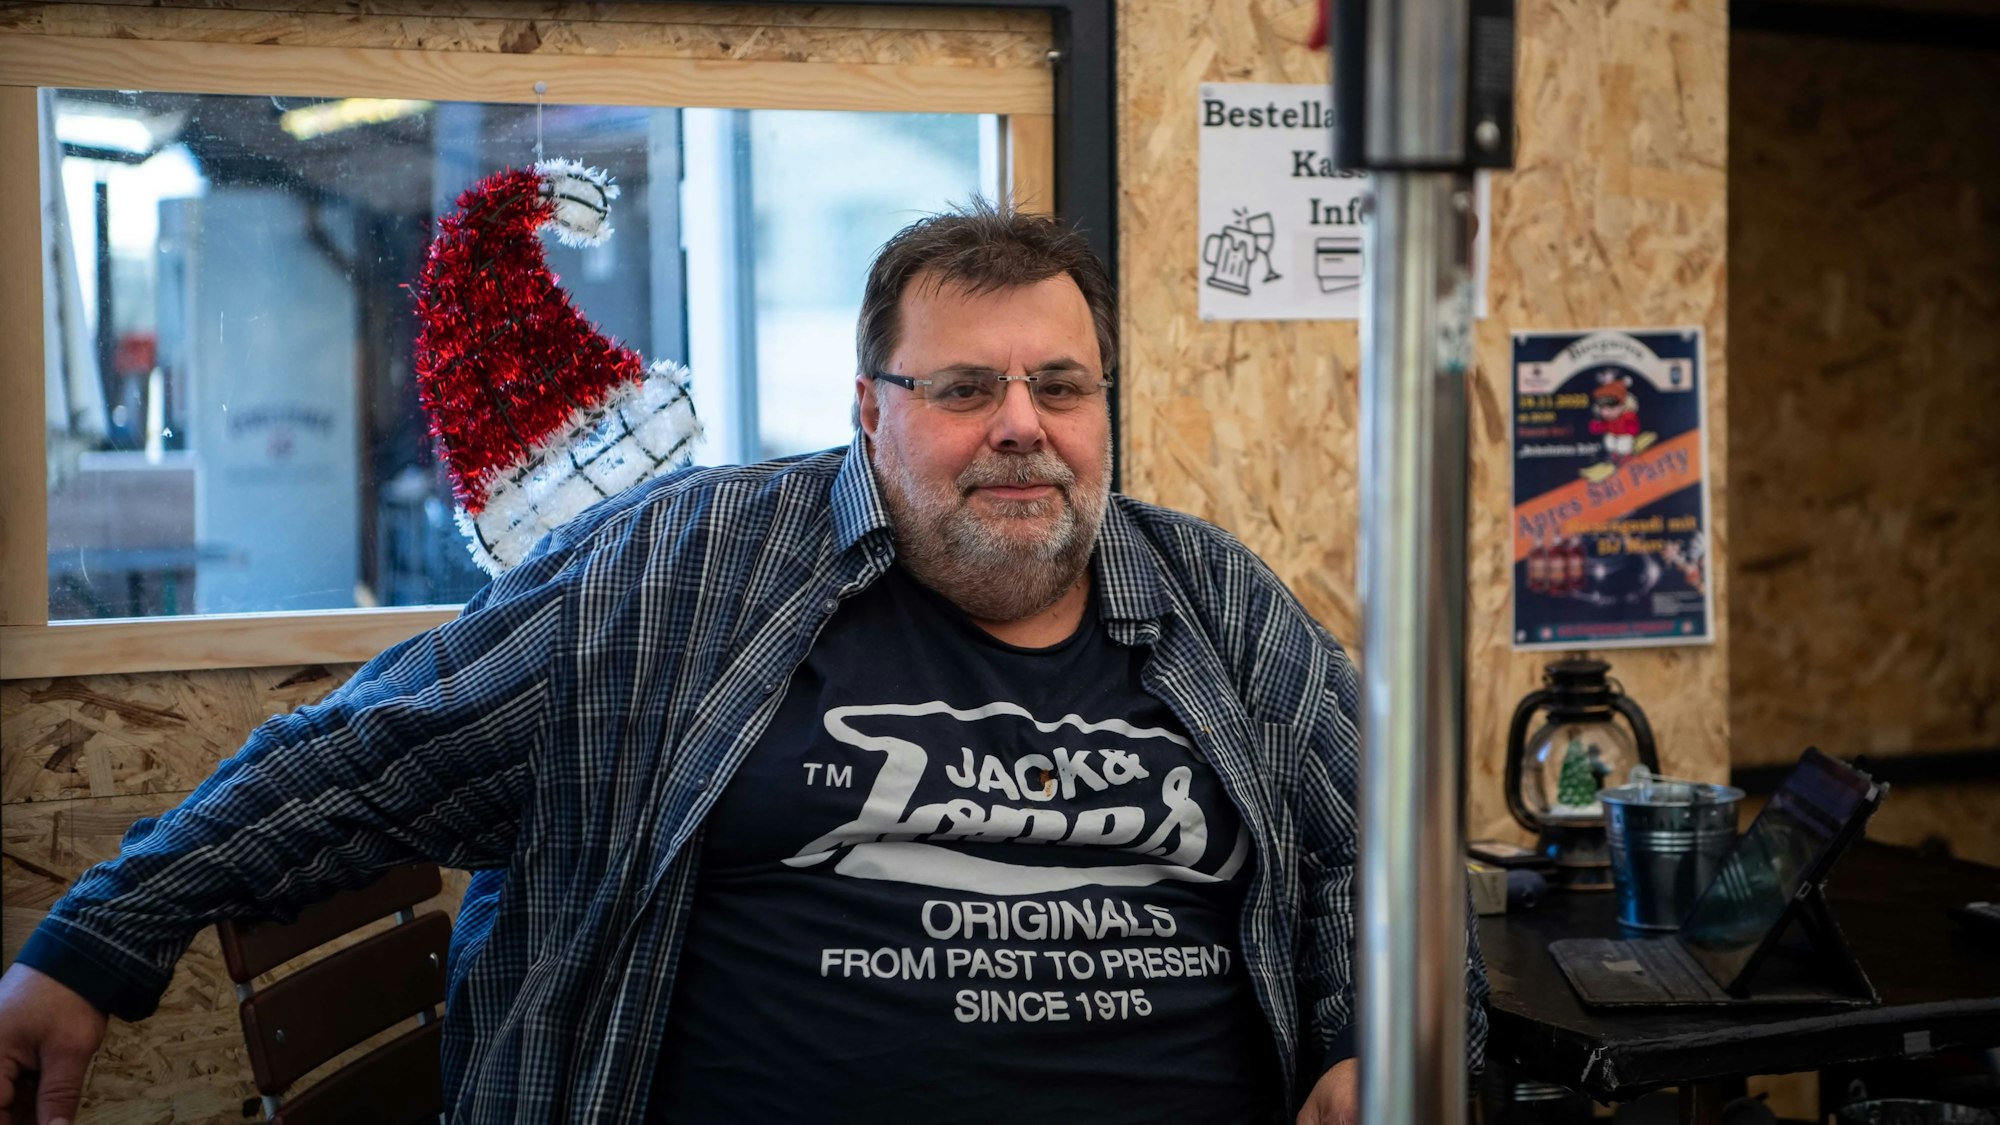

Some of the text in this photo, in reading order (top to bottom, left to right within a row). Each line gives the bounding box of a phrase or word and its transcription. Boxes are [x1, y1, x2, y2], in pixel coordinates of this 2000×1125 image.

[1587, 473, 1625, 507] Ski
[1629, 447, 1689, 488] Party
[803, 762, 853, 788] TM
[921, 899, 1177, 941] ORIGINALS
[820, 944, 1232, 981] FROM PAST TO PRESENT
[954, 988, 1153, 1023] SINCE 1975
